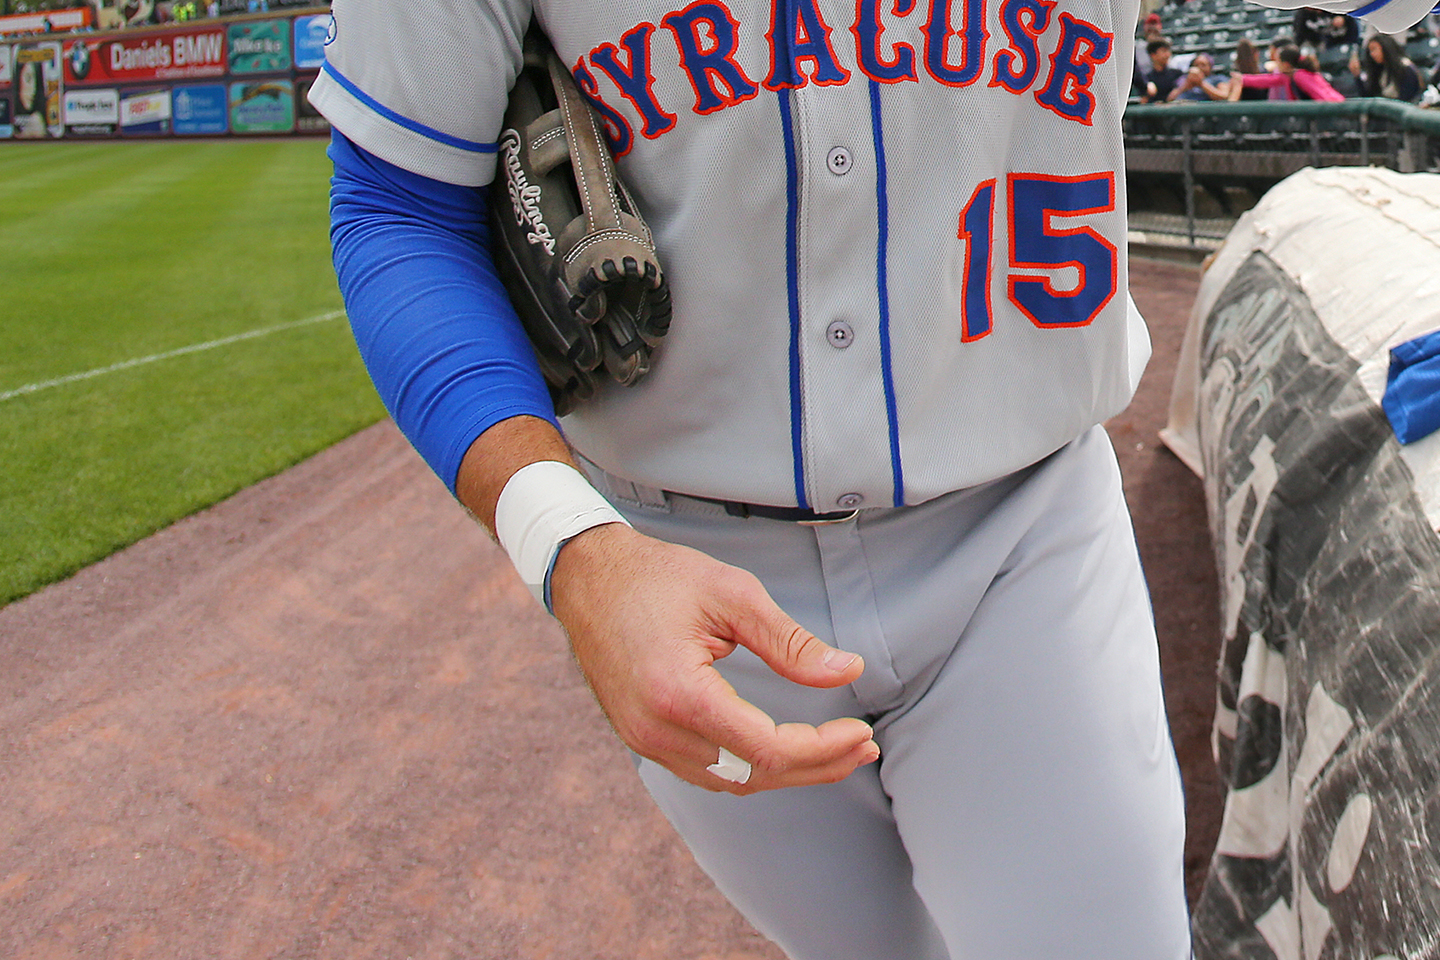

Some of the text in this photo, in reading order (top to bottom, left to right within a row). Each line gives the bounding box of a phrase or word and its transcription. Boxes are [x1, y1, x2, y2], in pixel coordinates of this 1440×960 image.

[110, 39, 172, 71] Daniels
[173, 33, 223, 65] BMW
[499, 128, 555, 257] Rawlings
[958, 170, 1118, 344] 15
